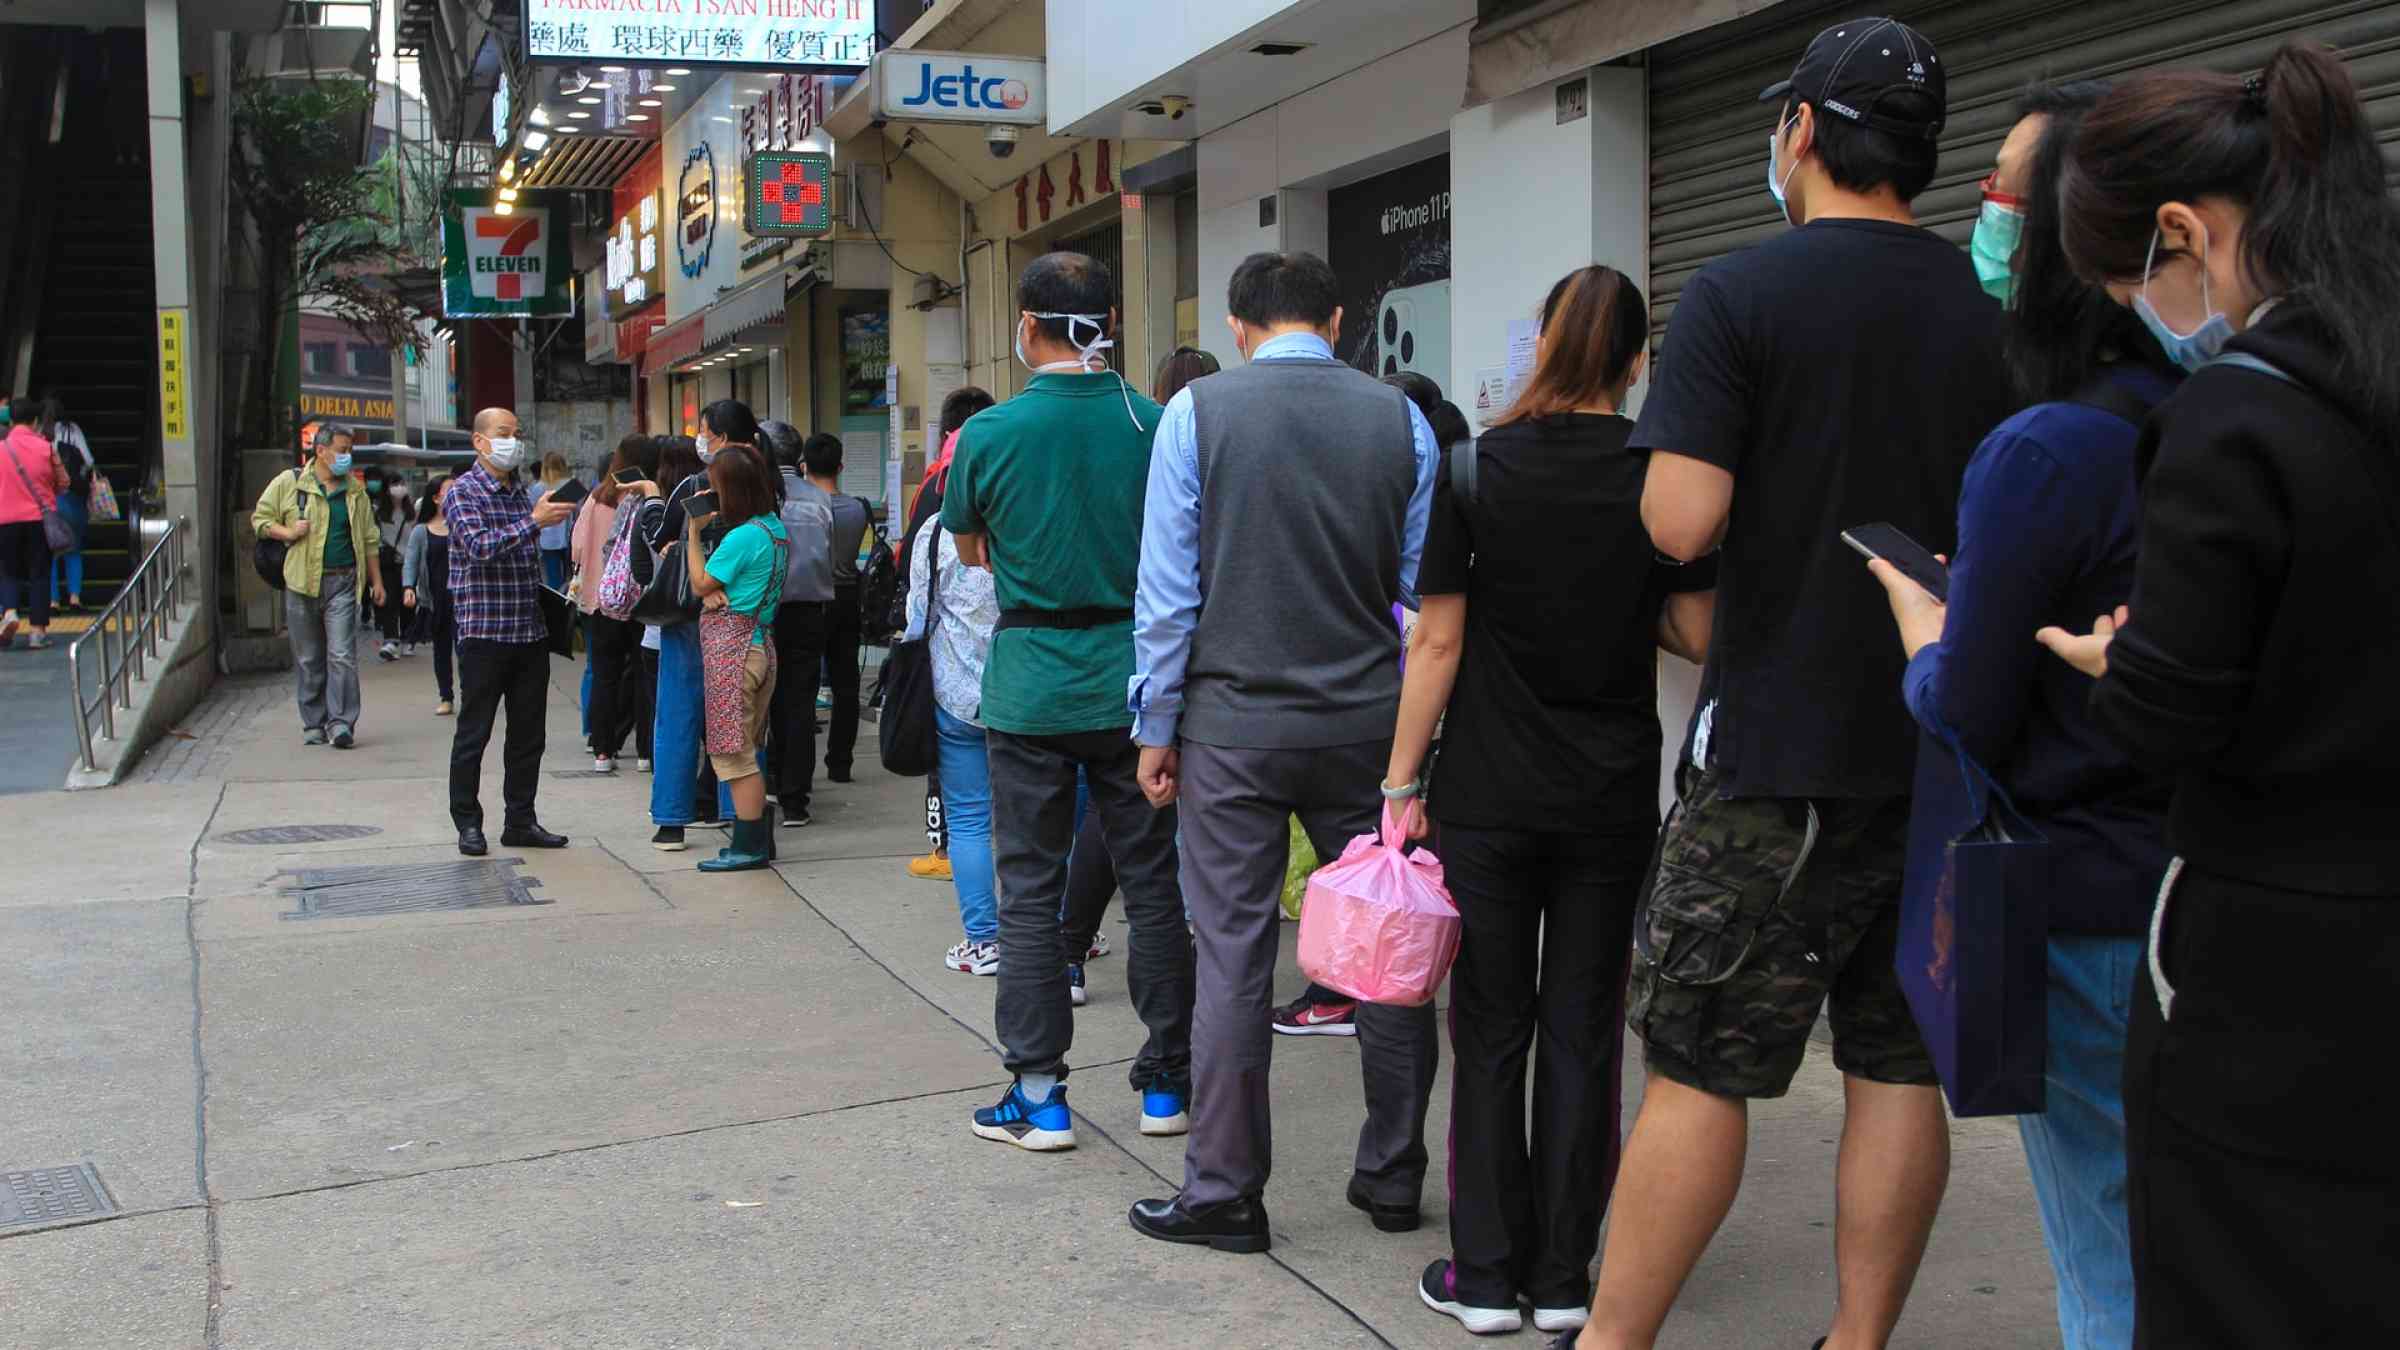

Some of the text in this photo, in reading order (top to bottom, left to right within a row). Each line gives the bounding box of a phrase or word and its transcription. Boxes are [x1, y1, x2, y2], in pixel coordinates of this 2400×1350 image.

[694, 0, 757, 16] TSAN
[767, 0, 836, 18] HENG
[611, 24, 743, 59] 環球西藥
[1390, 204, 1429, 233] iPhone
[1430, 194, 1440, 221] 11
[315, 395, 359, 417] DELTA
[364, 399, 394, 418] ASIA
